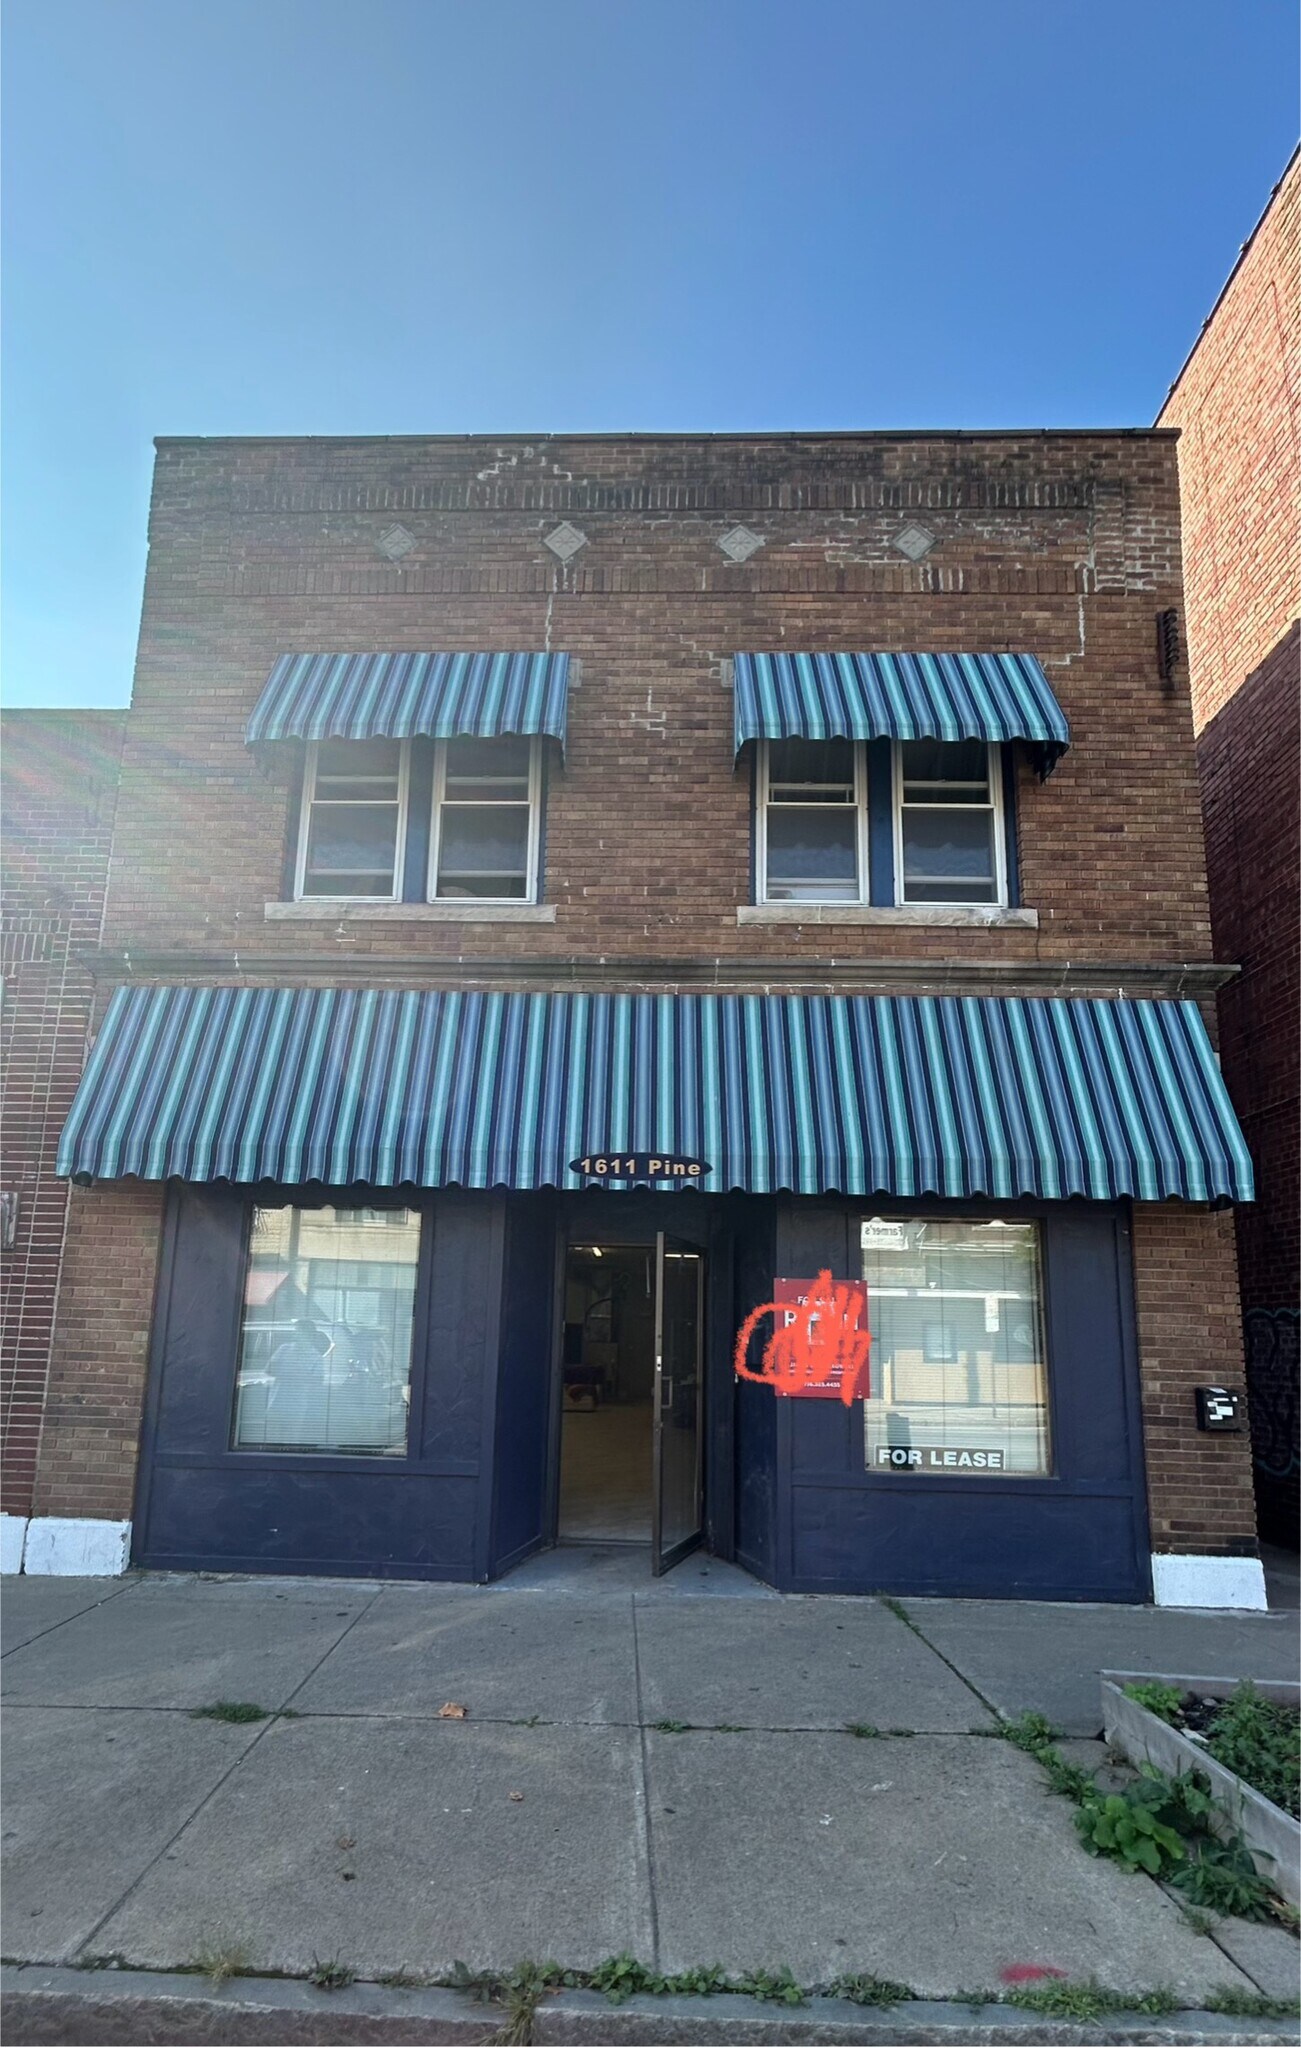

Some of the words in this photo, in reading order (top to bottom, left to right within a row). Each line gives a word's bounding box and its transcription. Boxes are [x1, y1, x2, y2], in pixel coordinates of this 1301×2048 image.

[580, 1158, 636, 1174] 1611
[648, 1160, 701, 1175] Pine
[878, 1448, 923, 1465] FOR
[930, 1450, 1001, 1468] LEASE
